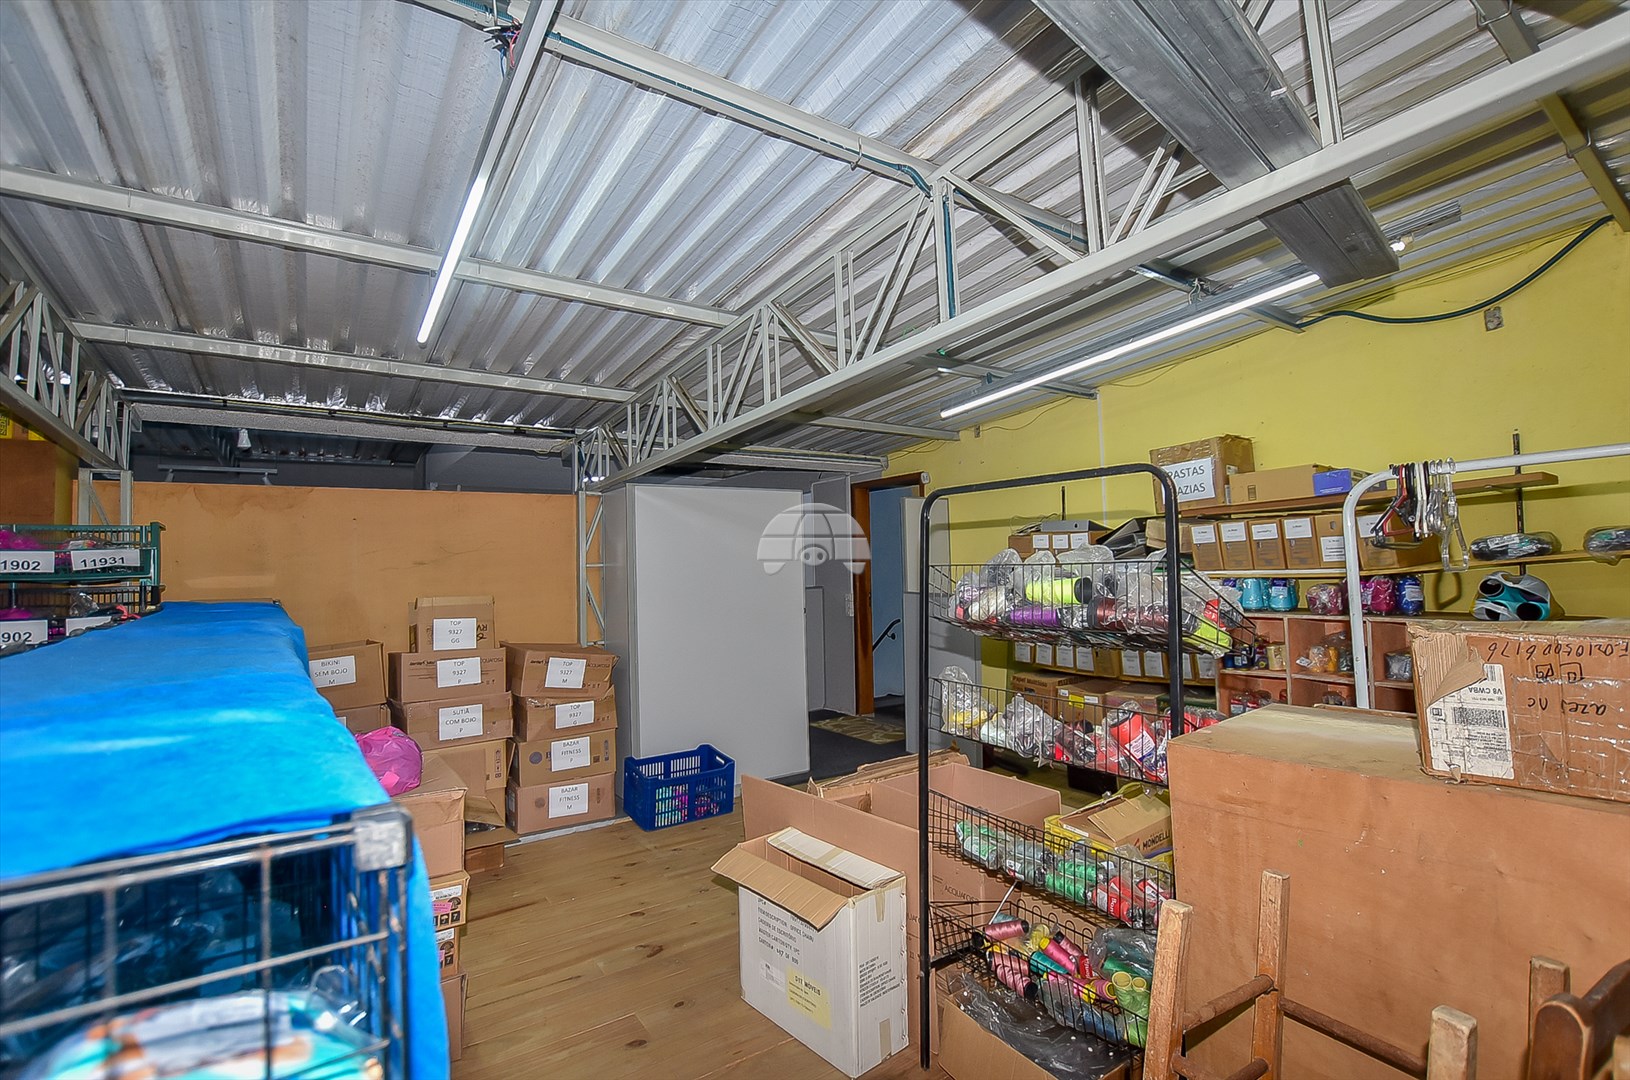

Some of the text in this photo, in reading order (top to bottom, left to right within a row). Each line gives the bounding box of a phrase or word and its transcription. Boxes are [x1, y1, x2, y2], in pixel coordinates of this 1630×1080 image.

[1177, 482, 1206, 495] AZIAS
[80, 556, 126, 568] 11931
[330, 667, 348, 675] BOJO
[562, 740, 580, 748] BAZAR
[561, 748, 582, 756] FITNESS
[560, 786, 578, 794] BAZAR
